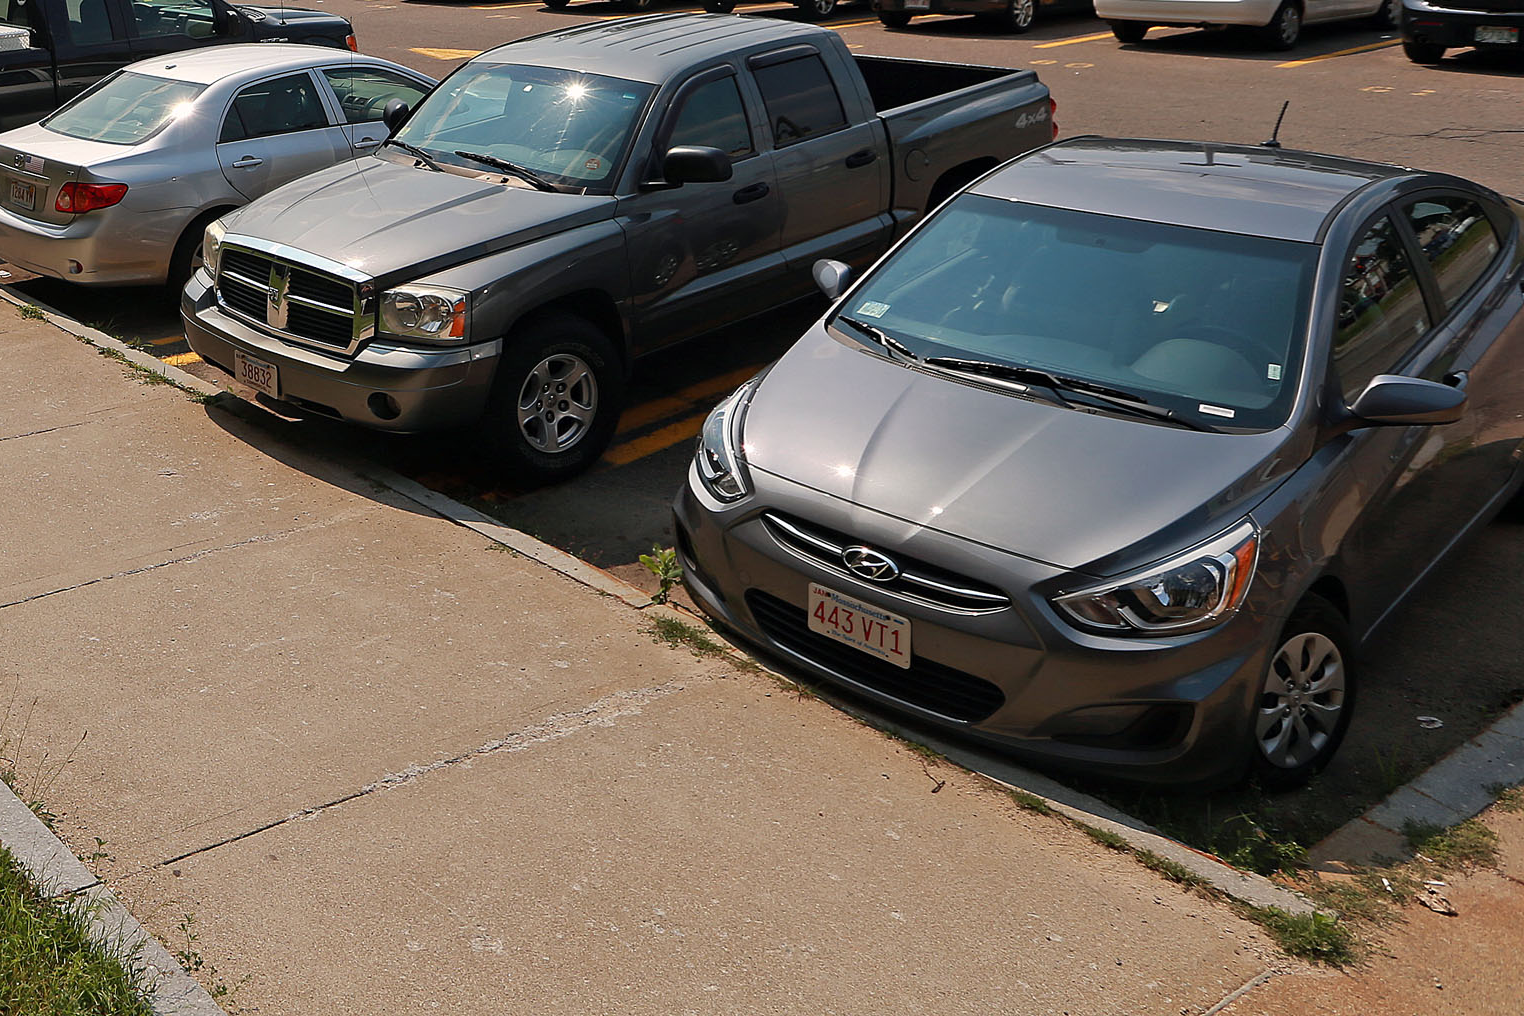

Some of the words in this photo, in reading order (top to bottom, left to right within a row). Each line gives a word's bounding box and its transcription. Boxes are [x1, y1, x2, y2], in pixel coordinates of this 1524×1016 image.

[241, 360, 272, 389] 38832
[813, 600, 854, 634] 443
[861, 616, 903, 656] VT1
